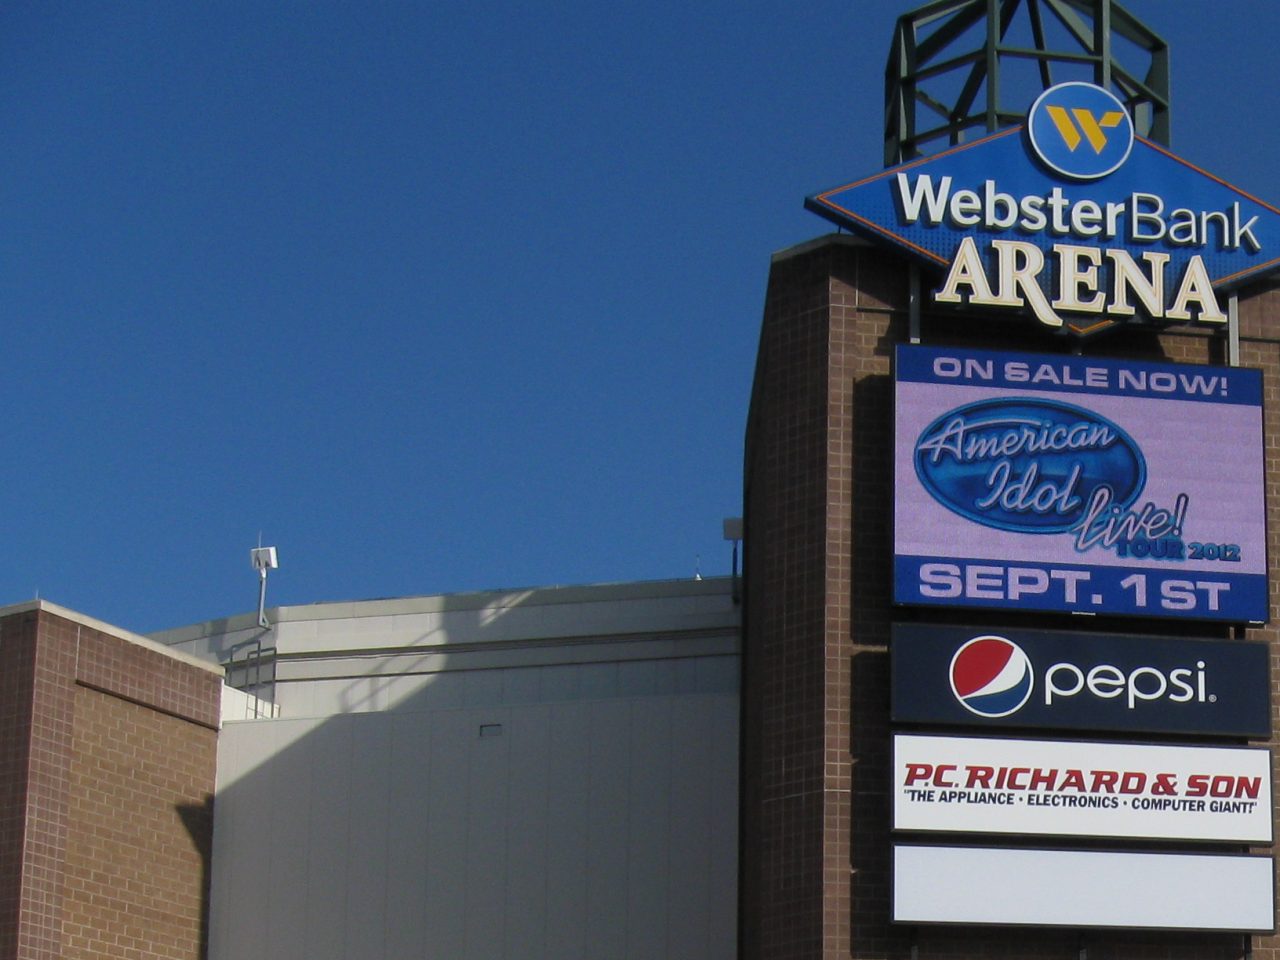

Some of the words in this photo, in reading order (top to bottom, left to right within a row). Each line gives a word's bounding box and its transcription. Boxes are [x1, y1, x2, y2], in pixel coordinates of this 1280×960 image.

[935, 236, 1228, 327] ARENA
[932, 357, 995, 381] ON
[1004, 362, 1109, 388] SALE
[1118, 369, 1228, 396] NOW!
[918, 418, 1117, 462] American
[978, 461, 1081, 512] Idol
[1116, 539, 1184, 559] TOUR
[1188, 542, 1242, 562] 2012
[919, 563, 1103, 604] SEPT.
[1120, 573, 1231, 611] 1ST
[1045, 660, 1206, 709] pepsi
[939, 791, 1015, 805] APPLIANCE
[1027, 794, 1119, 809] ELECTRONICS
[1131, 797, 1205, 812] COMPUTER
[1151, 773, 1179, 796] &
[1185, 775, 1262, 799] SON
